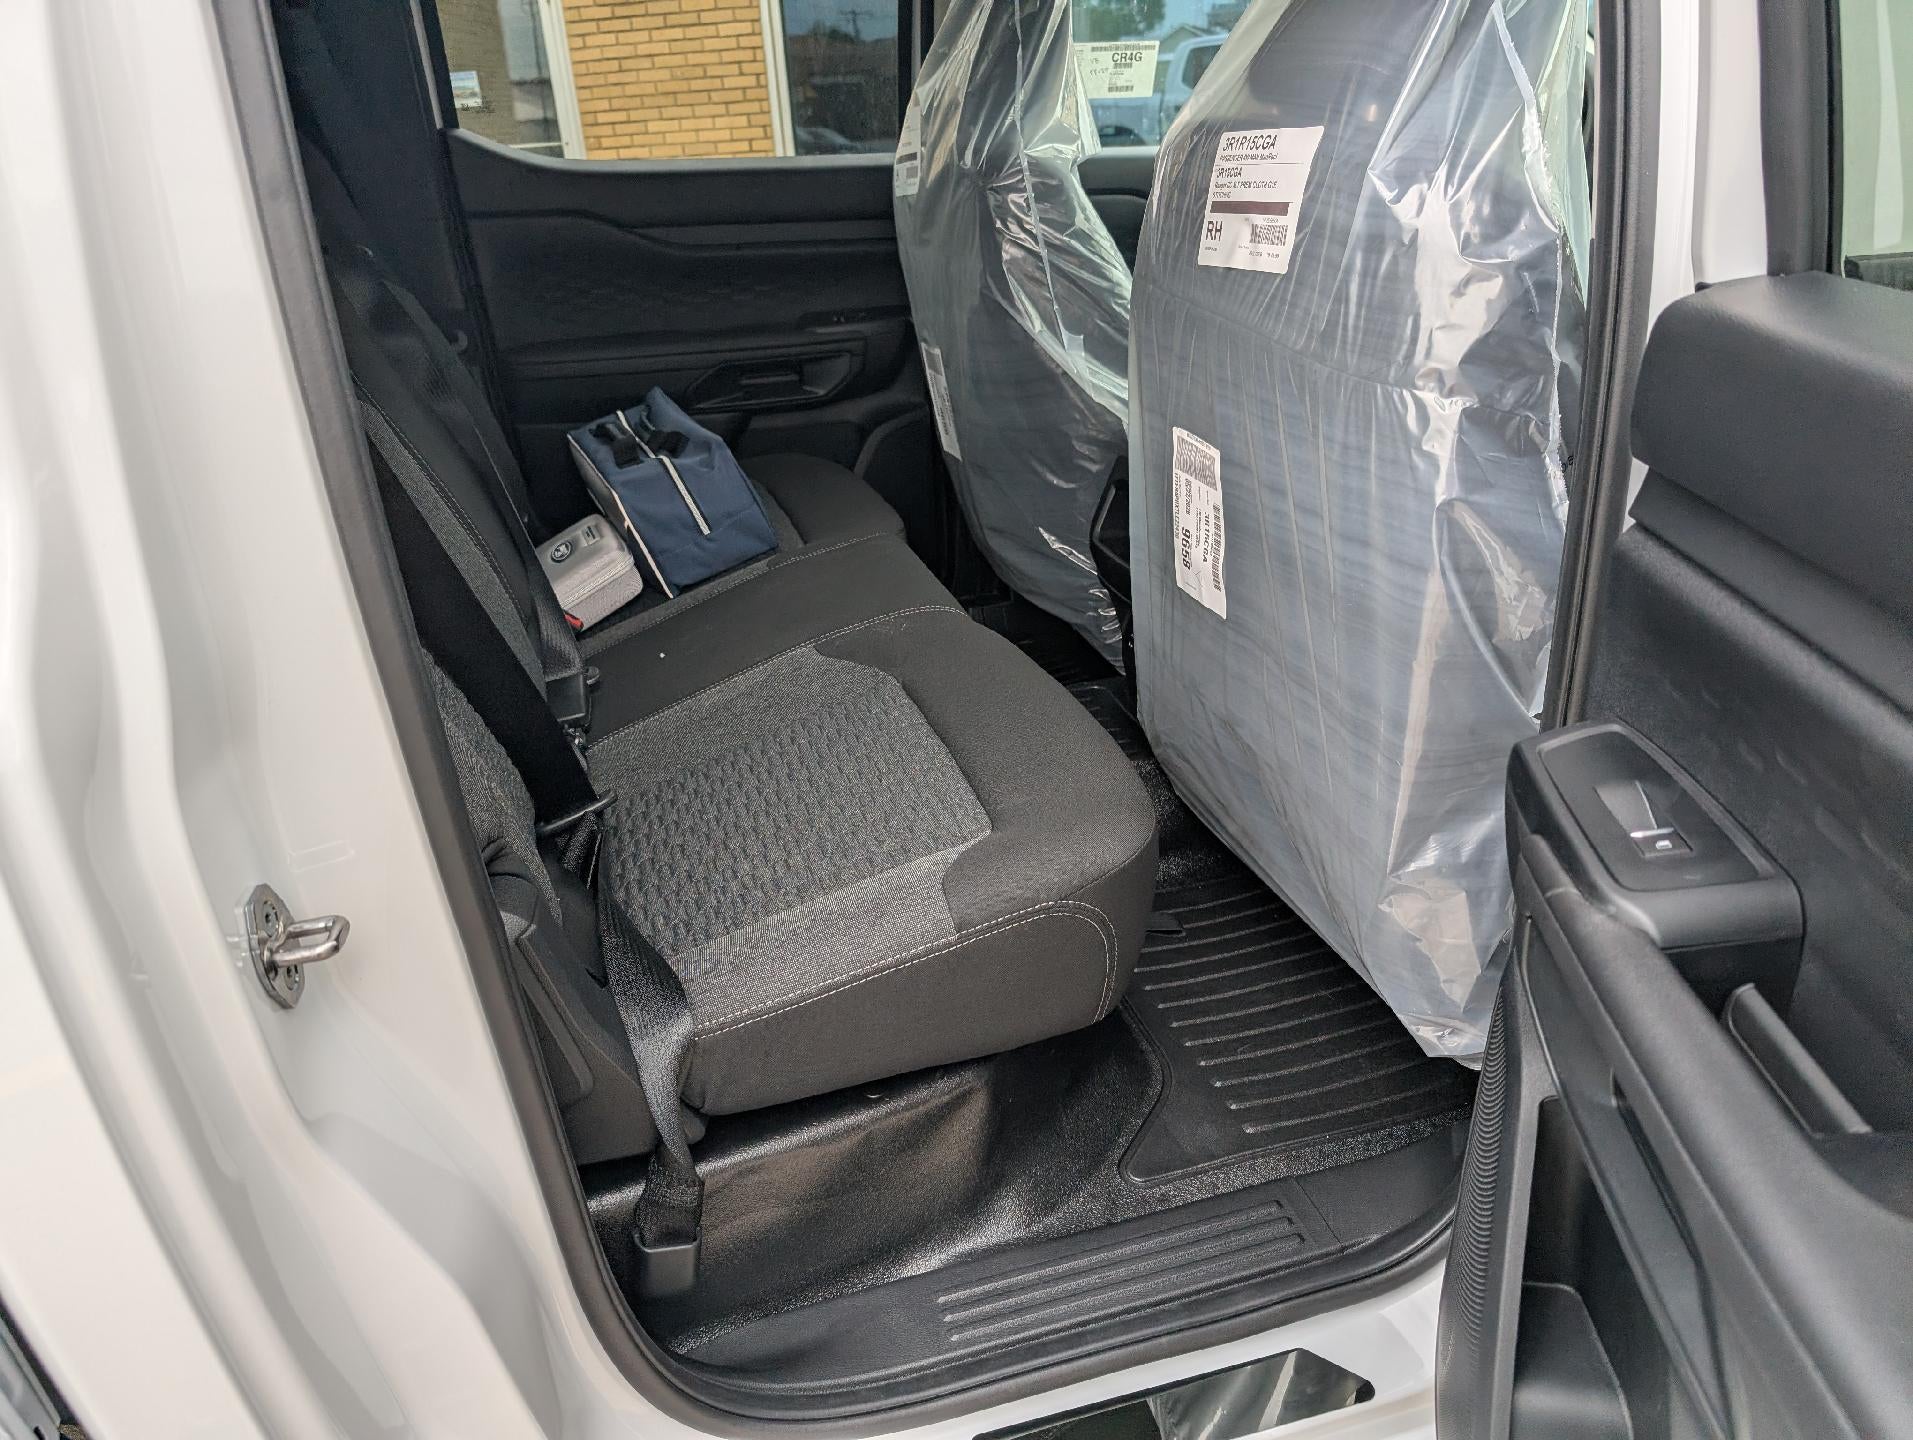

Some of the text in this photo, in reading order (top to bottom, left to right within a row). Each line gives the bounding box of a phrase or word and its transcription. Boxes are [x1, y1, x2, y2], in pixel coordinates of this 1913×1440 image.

[1111, 51, 1143, 63] CR4G
[1222, 134, 1278, 152] 3R1R15CGA
[1205, 220, 1223, 242] RH
[1181, 526, 1191, 571] 9658
